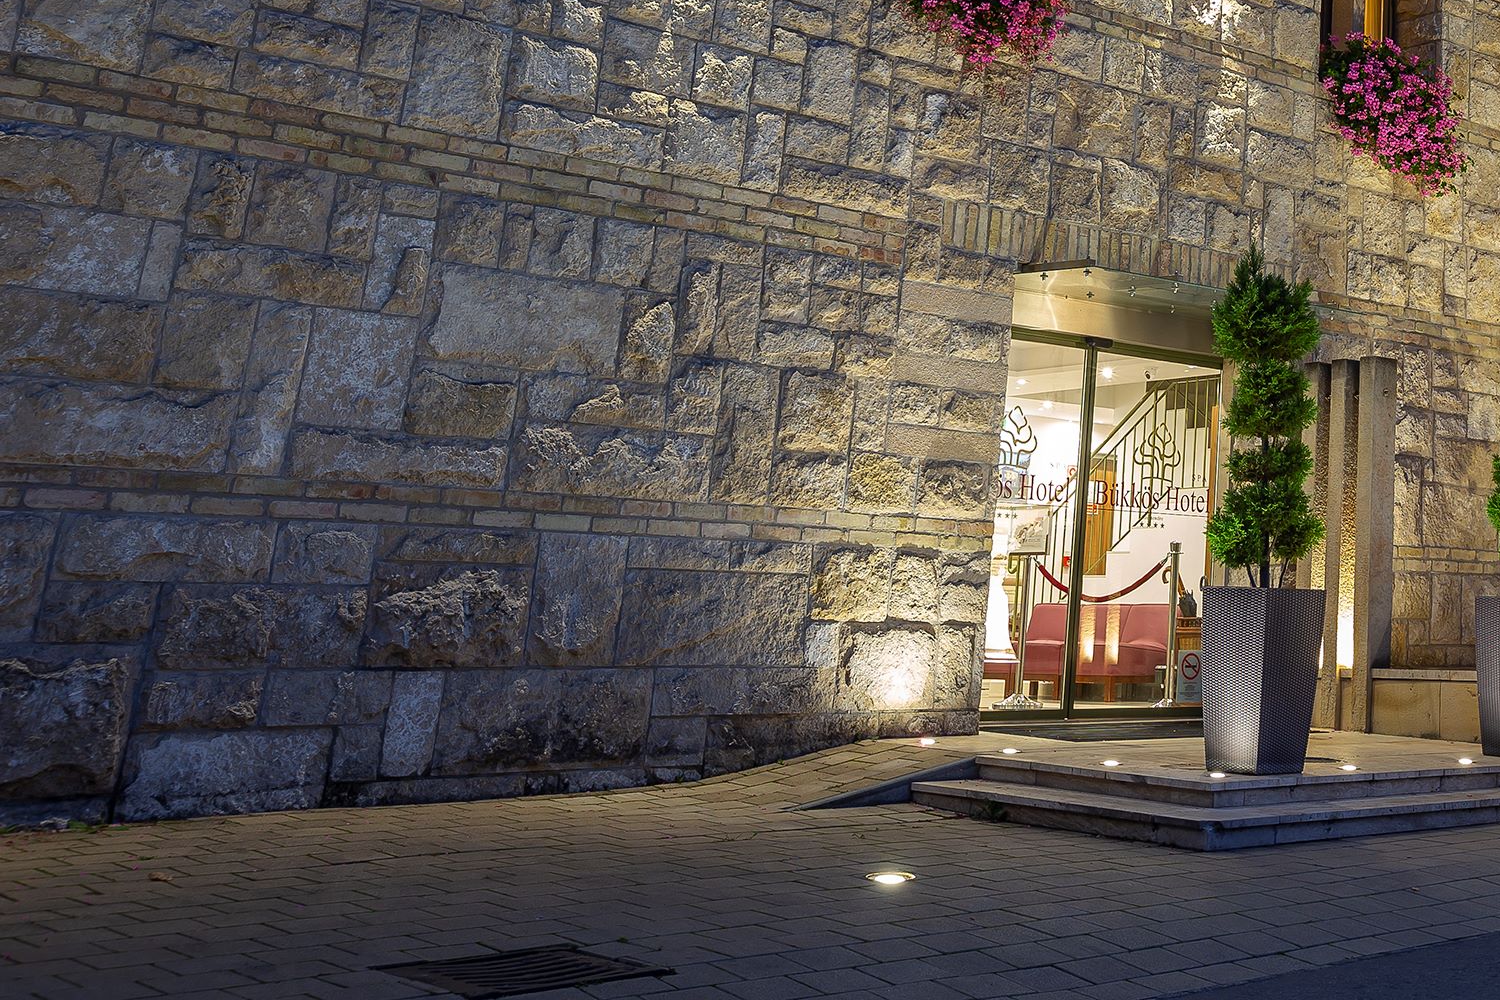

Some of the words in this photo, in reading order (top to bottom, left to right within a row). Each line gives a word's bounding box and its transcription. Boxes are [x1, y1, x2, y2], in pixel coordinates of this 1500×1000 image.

[1019, 473, 1070, 503] Hotel
[1095, 480, 1160, 510] Bükkös
[1165, 485, 1211, 514] Hotel
